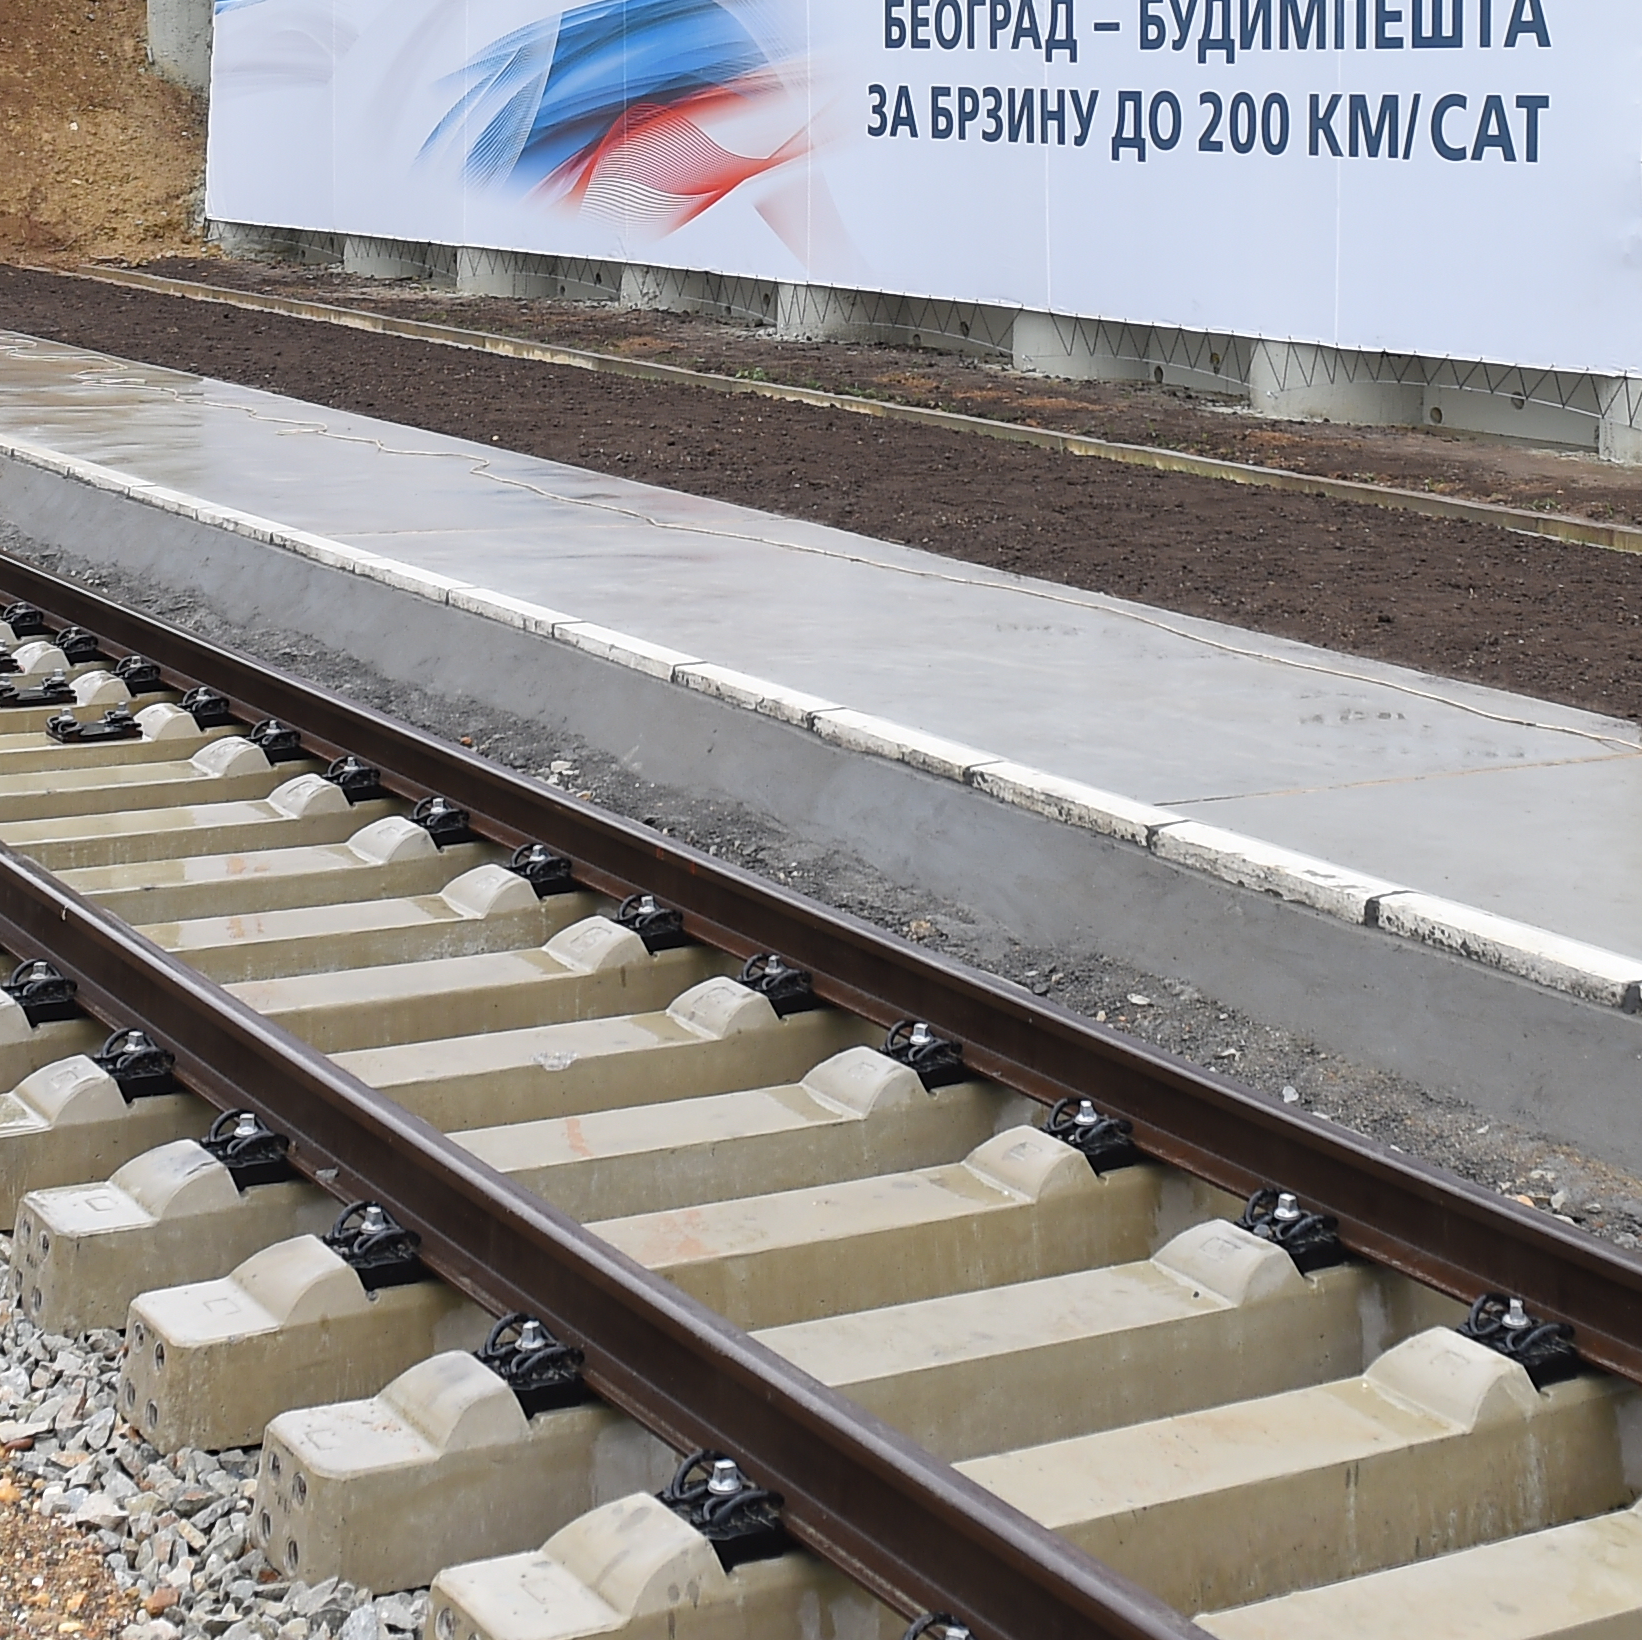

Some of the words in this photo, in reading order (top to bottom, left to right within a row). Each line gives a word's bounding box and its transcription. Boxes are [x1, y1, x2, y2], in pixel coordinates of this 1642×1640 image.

[867, 84, 918, 140] ЗА
[929, 86, 1099, 148] БРЗИНУ
[1111, 89, 1182, 162] ДО
[1198, 91, 1289, 155] 200
[1307, 92, 1551, 163] КМ/САТ
